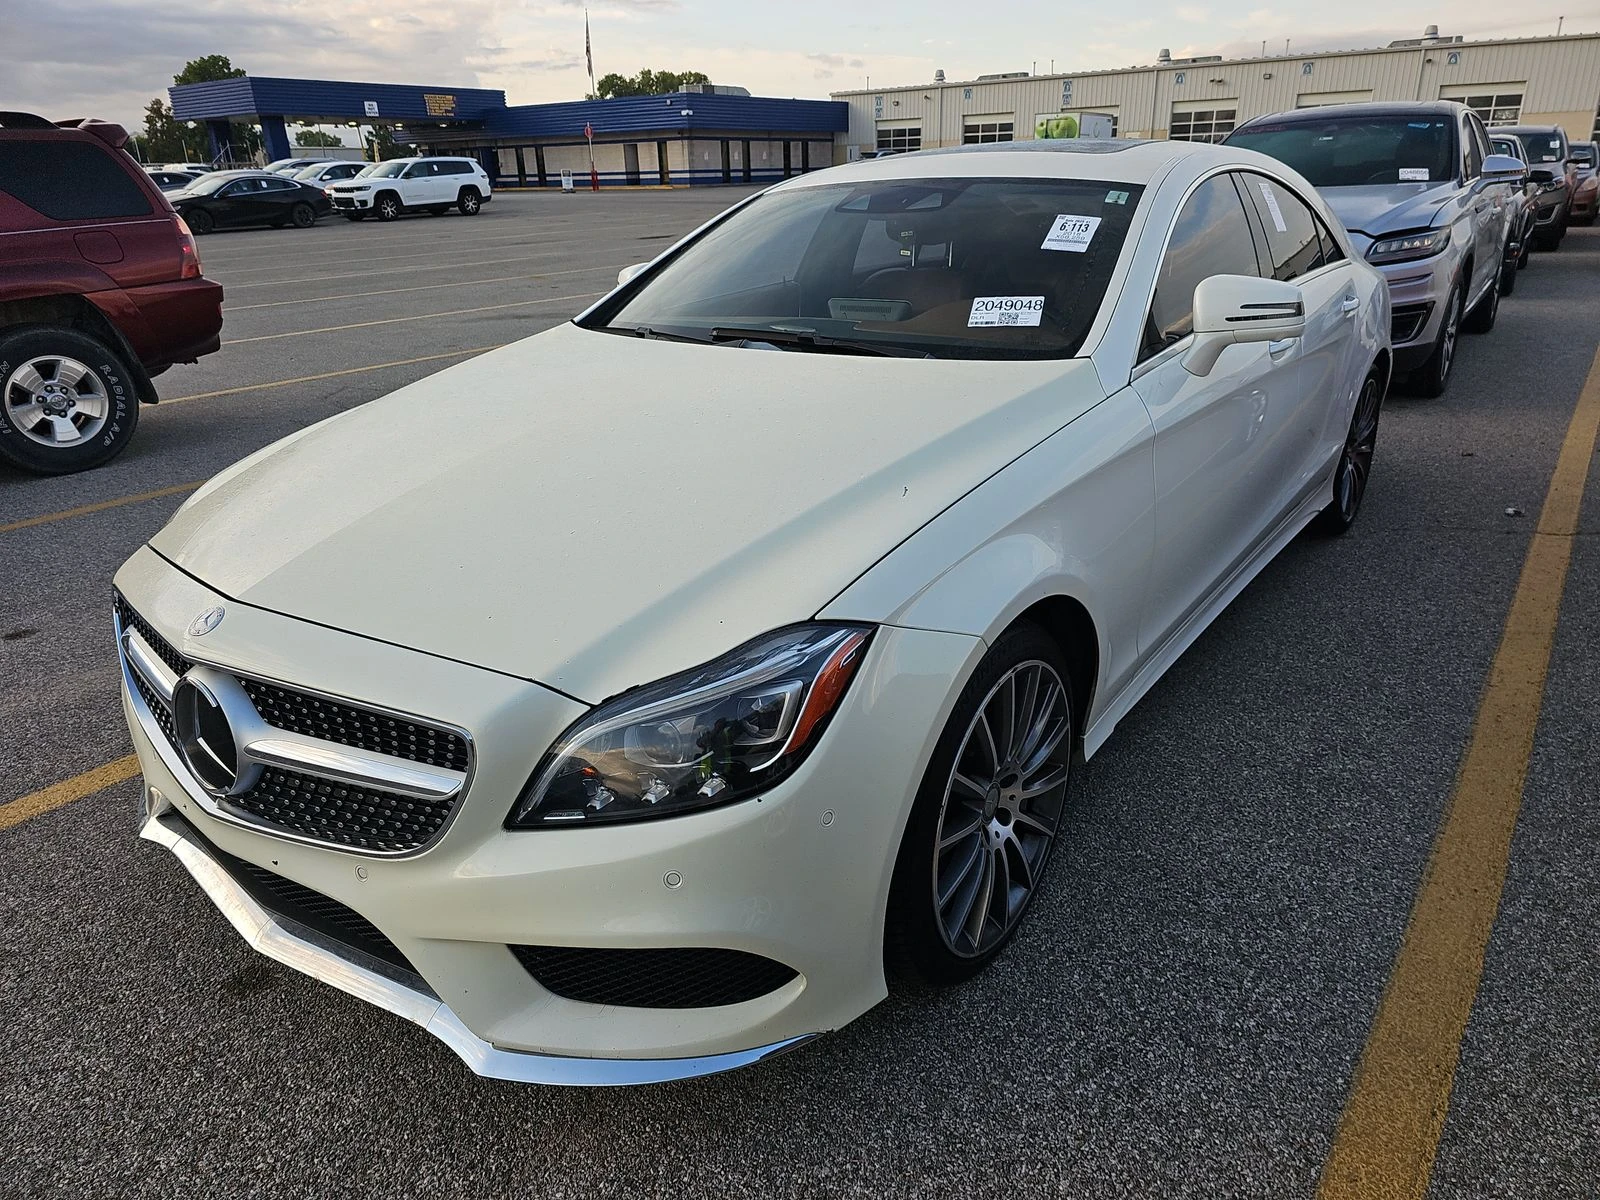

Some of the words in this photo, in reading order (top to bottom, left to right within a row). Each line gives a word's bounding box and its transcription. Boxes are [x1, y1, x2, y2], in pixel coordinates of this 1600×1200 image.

[1060, 221, 1090, 233] 6:113
[974, 299, 1043, 312] 2049048
[100, 364, 126, 420] RADIAL
[103, 422, 121, 447] A/P
